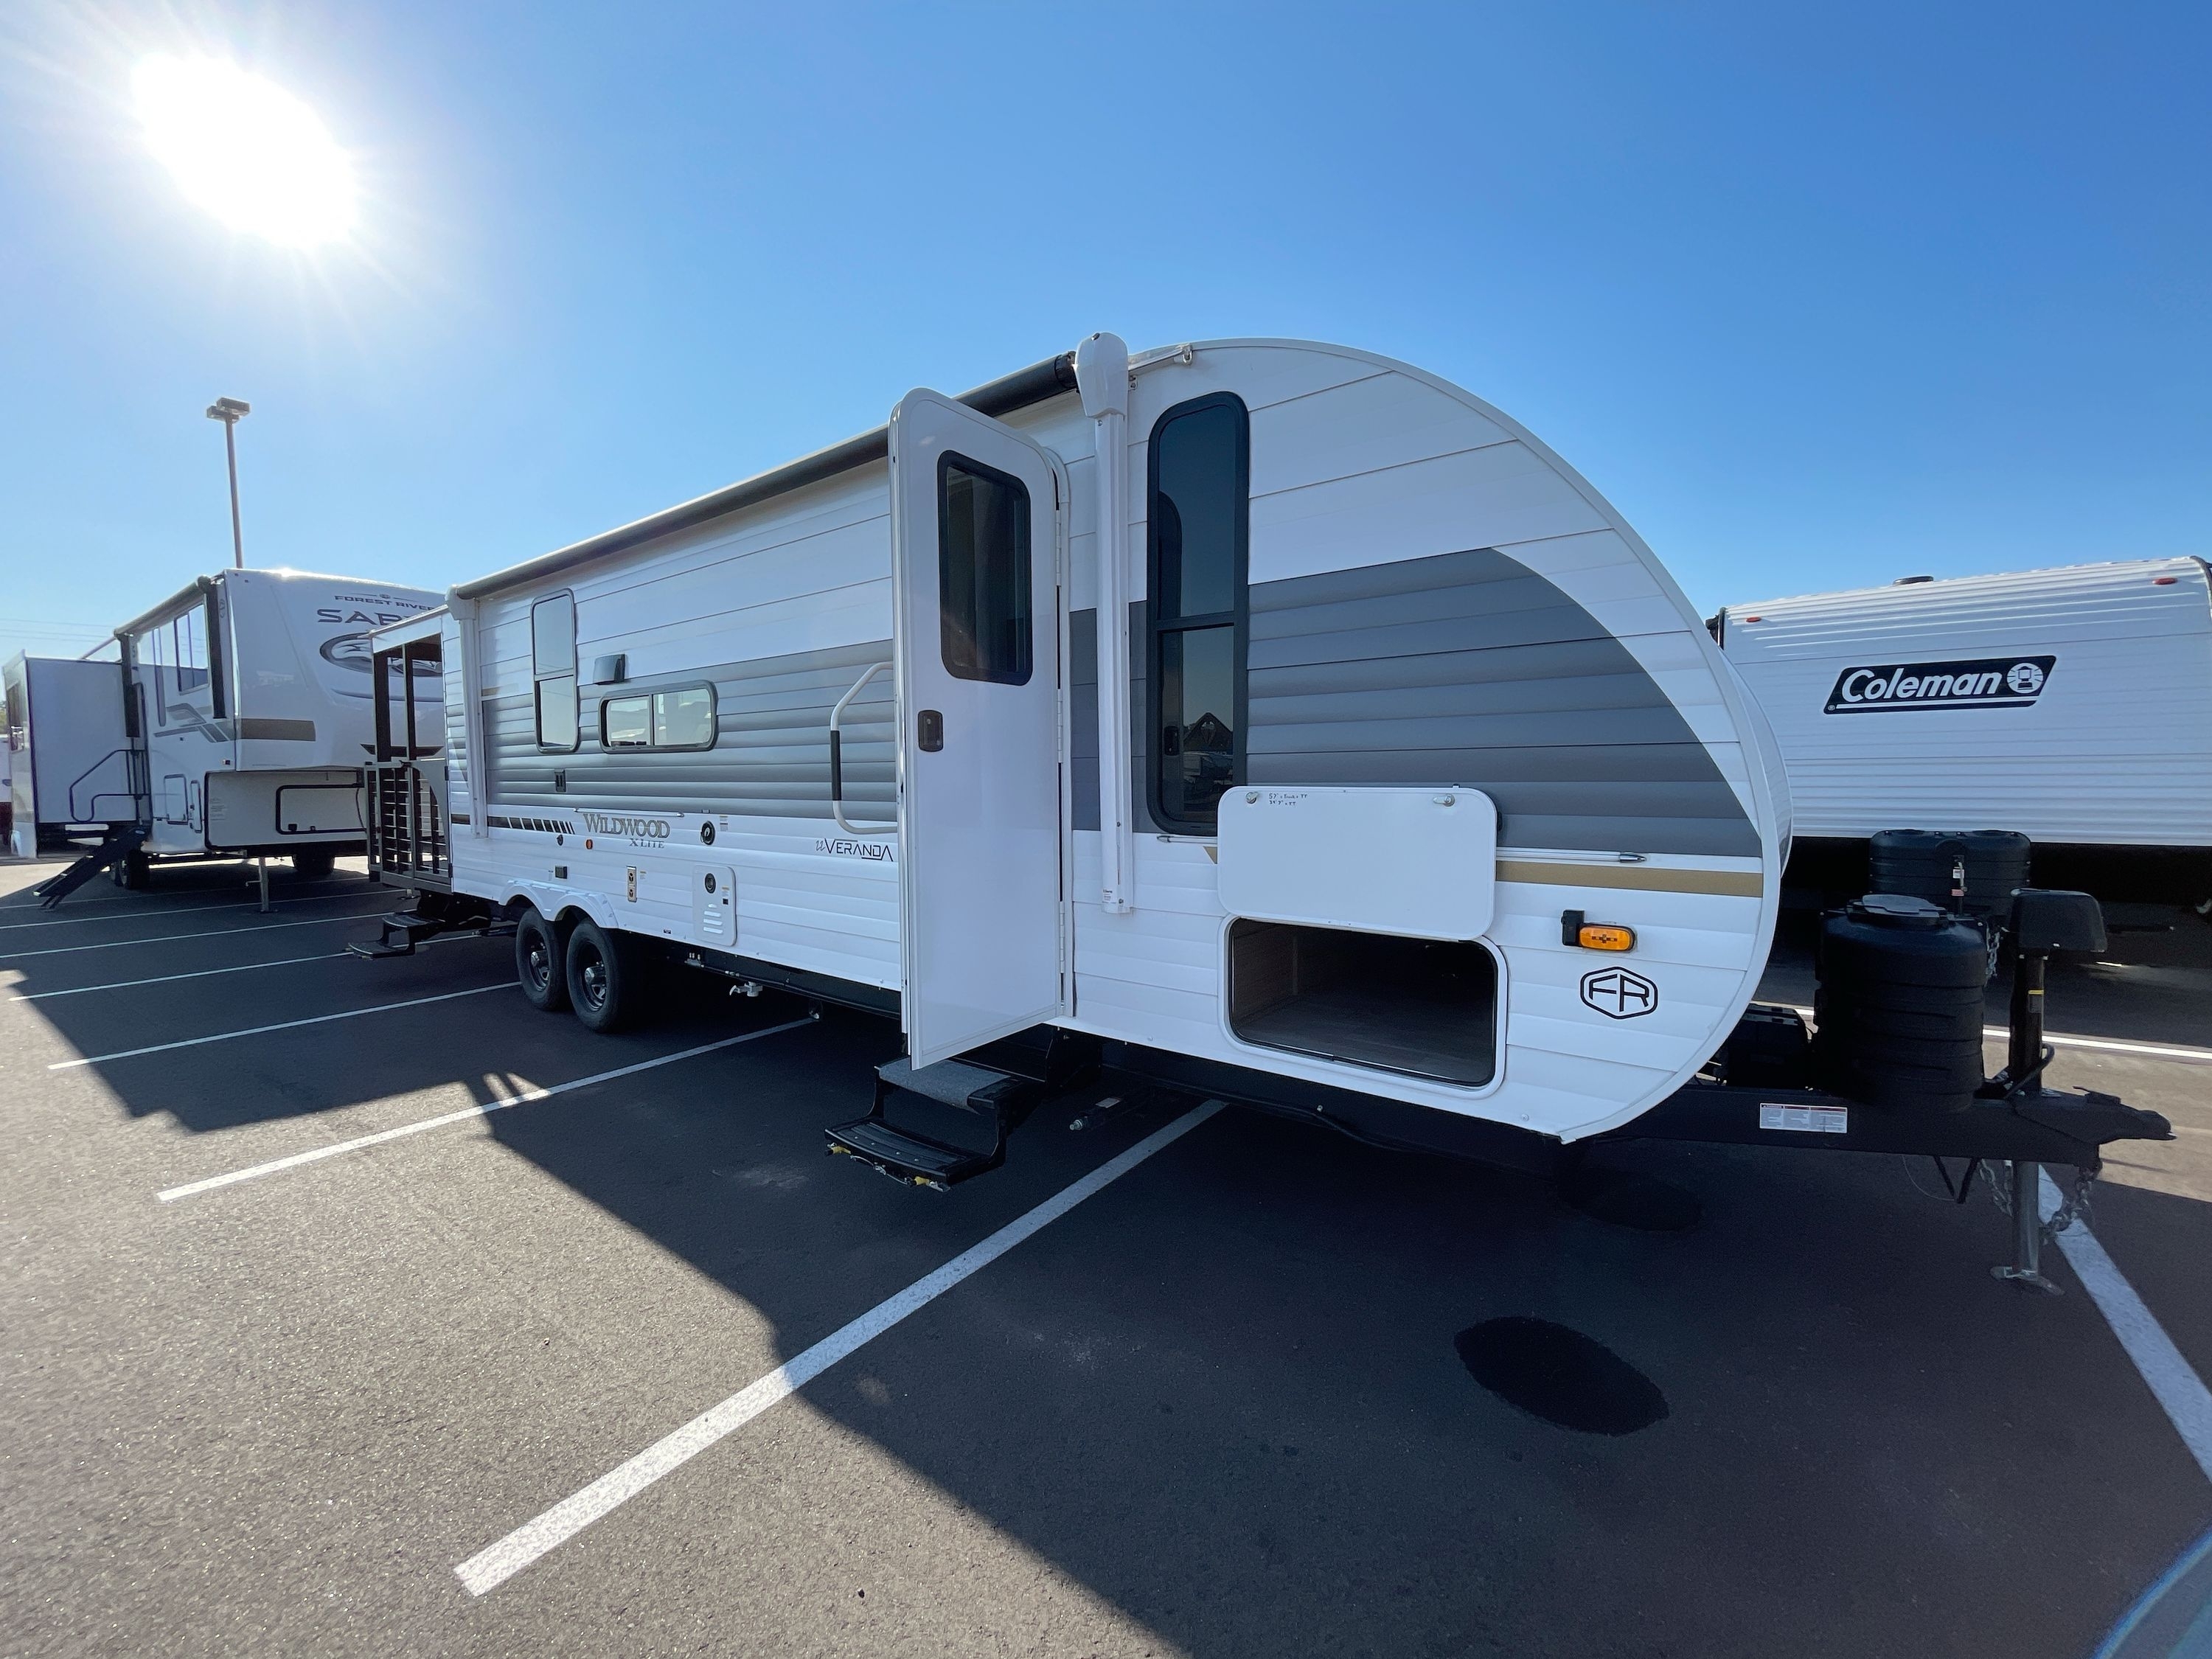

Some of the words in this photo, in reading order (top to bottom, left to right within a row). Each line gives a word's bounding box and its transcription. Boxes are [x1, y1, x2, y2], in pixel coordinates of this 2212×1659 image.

[334, 595, 392, 605] FOREST
[317, 609, 411, 626] SAB
[1842, 667, 2003, 703] Coleman
[583, 813, 670, 838] WILDWOOD
[1588, 973, 1649, 1012] FR
